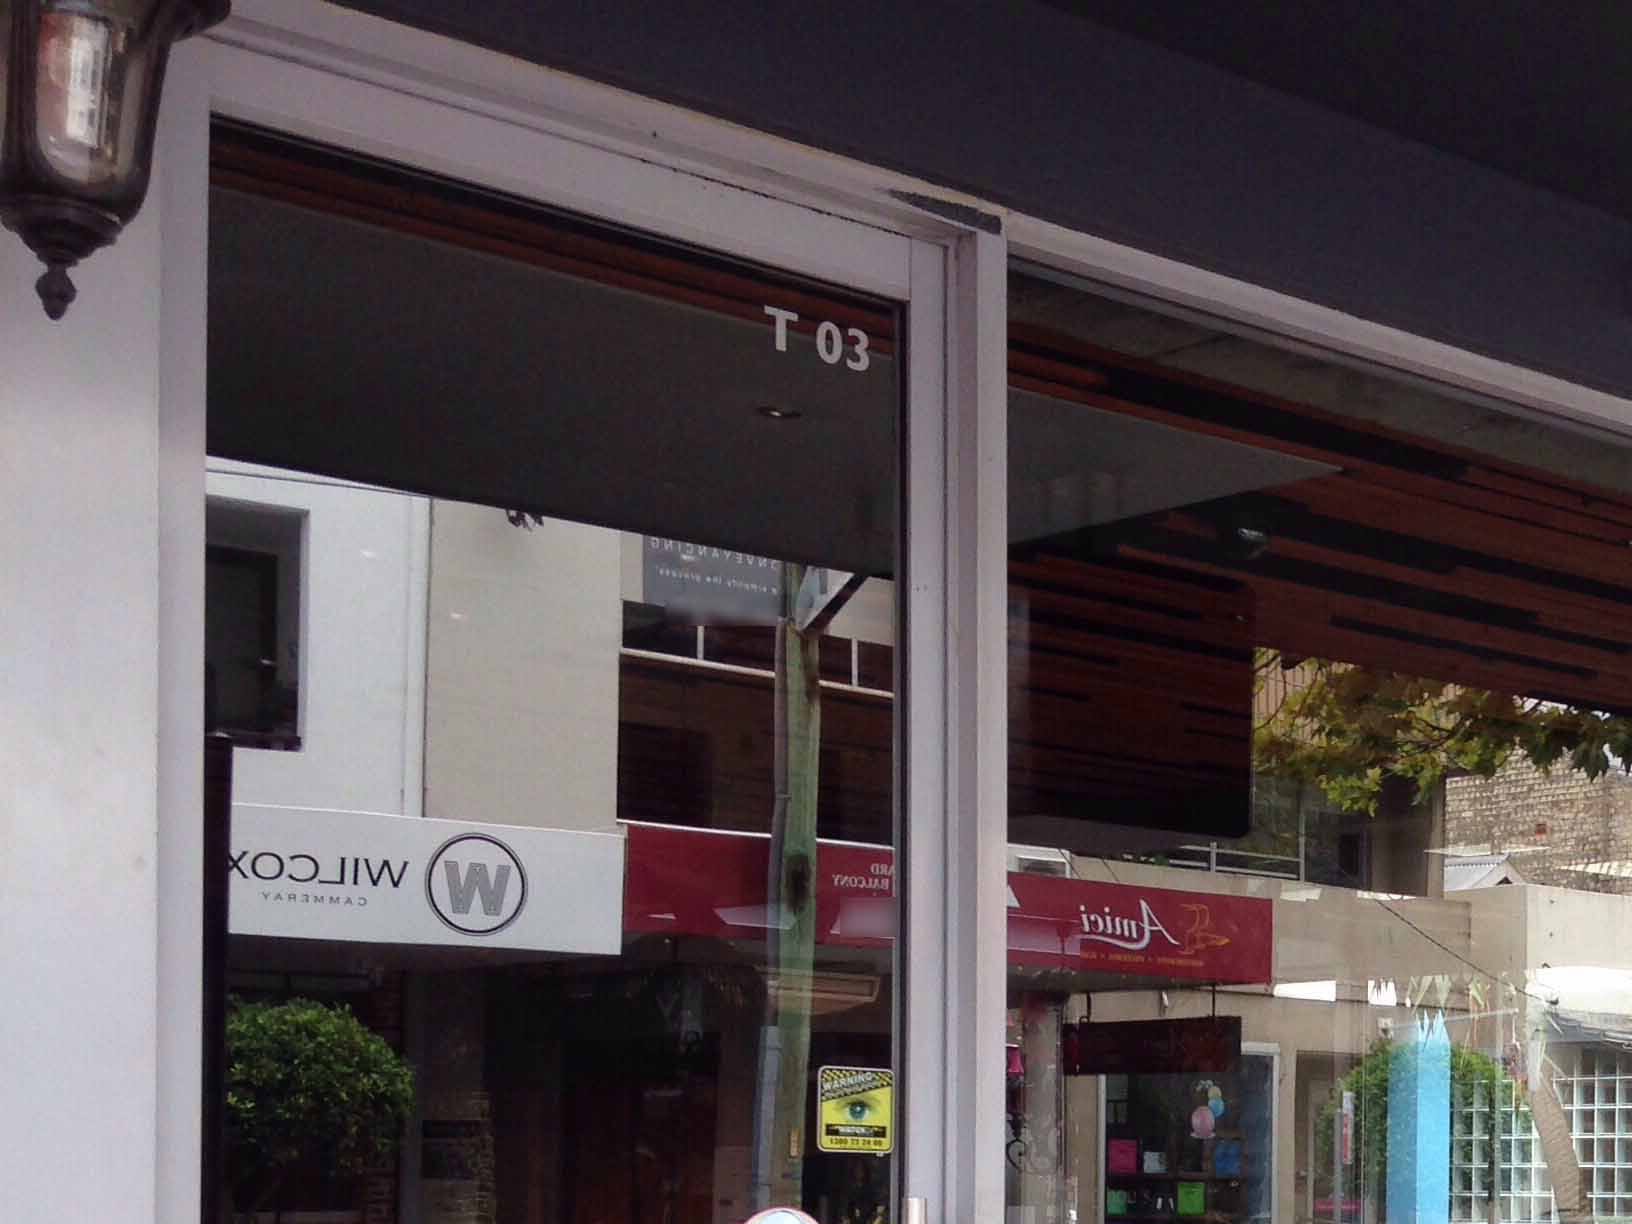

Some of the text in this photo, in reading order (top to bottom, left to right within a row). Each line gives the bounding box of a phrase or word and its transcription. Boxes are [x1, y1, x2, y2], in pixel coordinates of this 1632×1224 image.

[763, 304, 871, 372] T 03
[822, 1071, 874, 1090] WARNING
